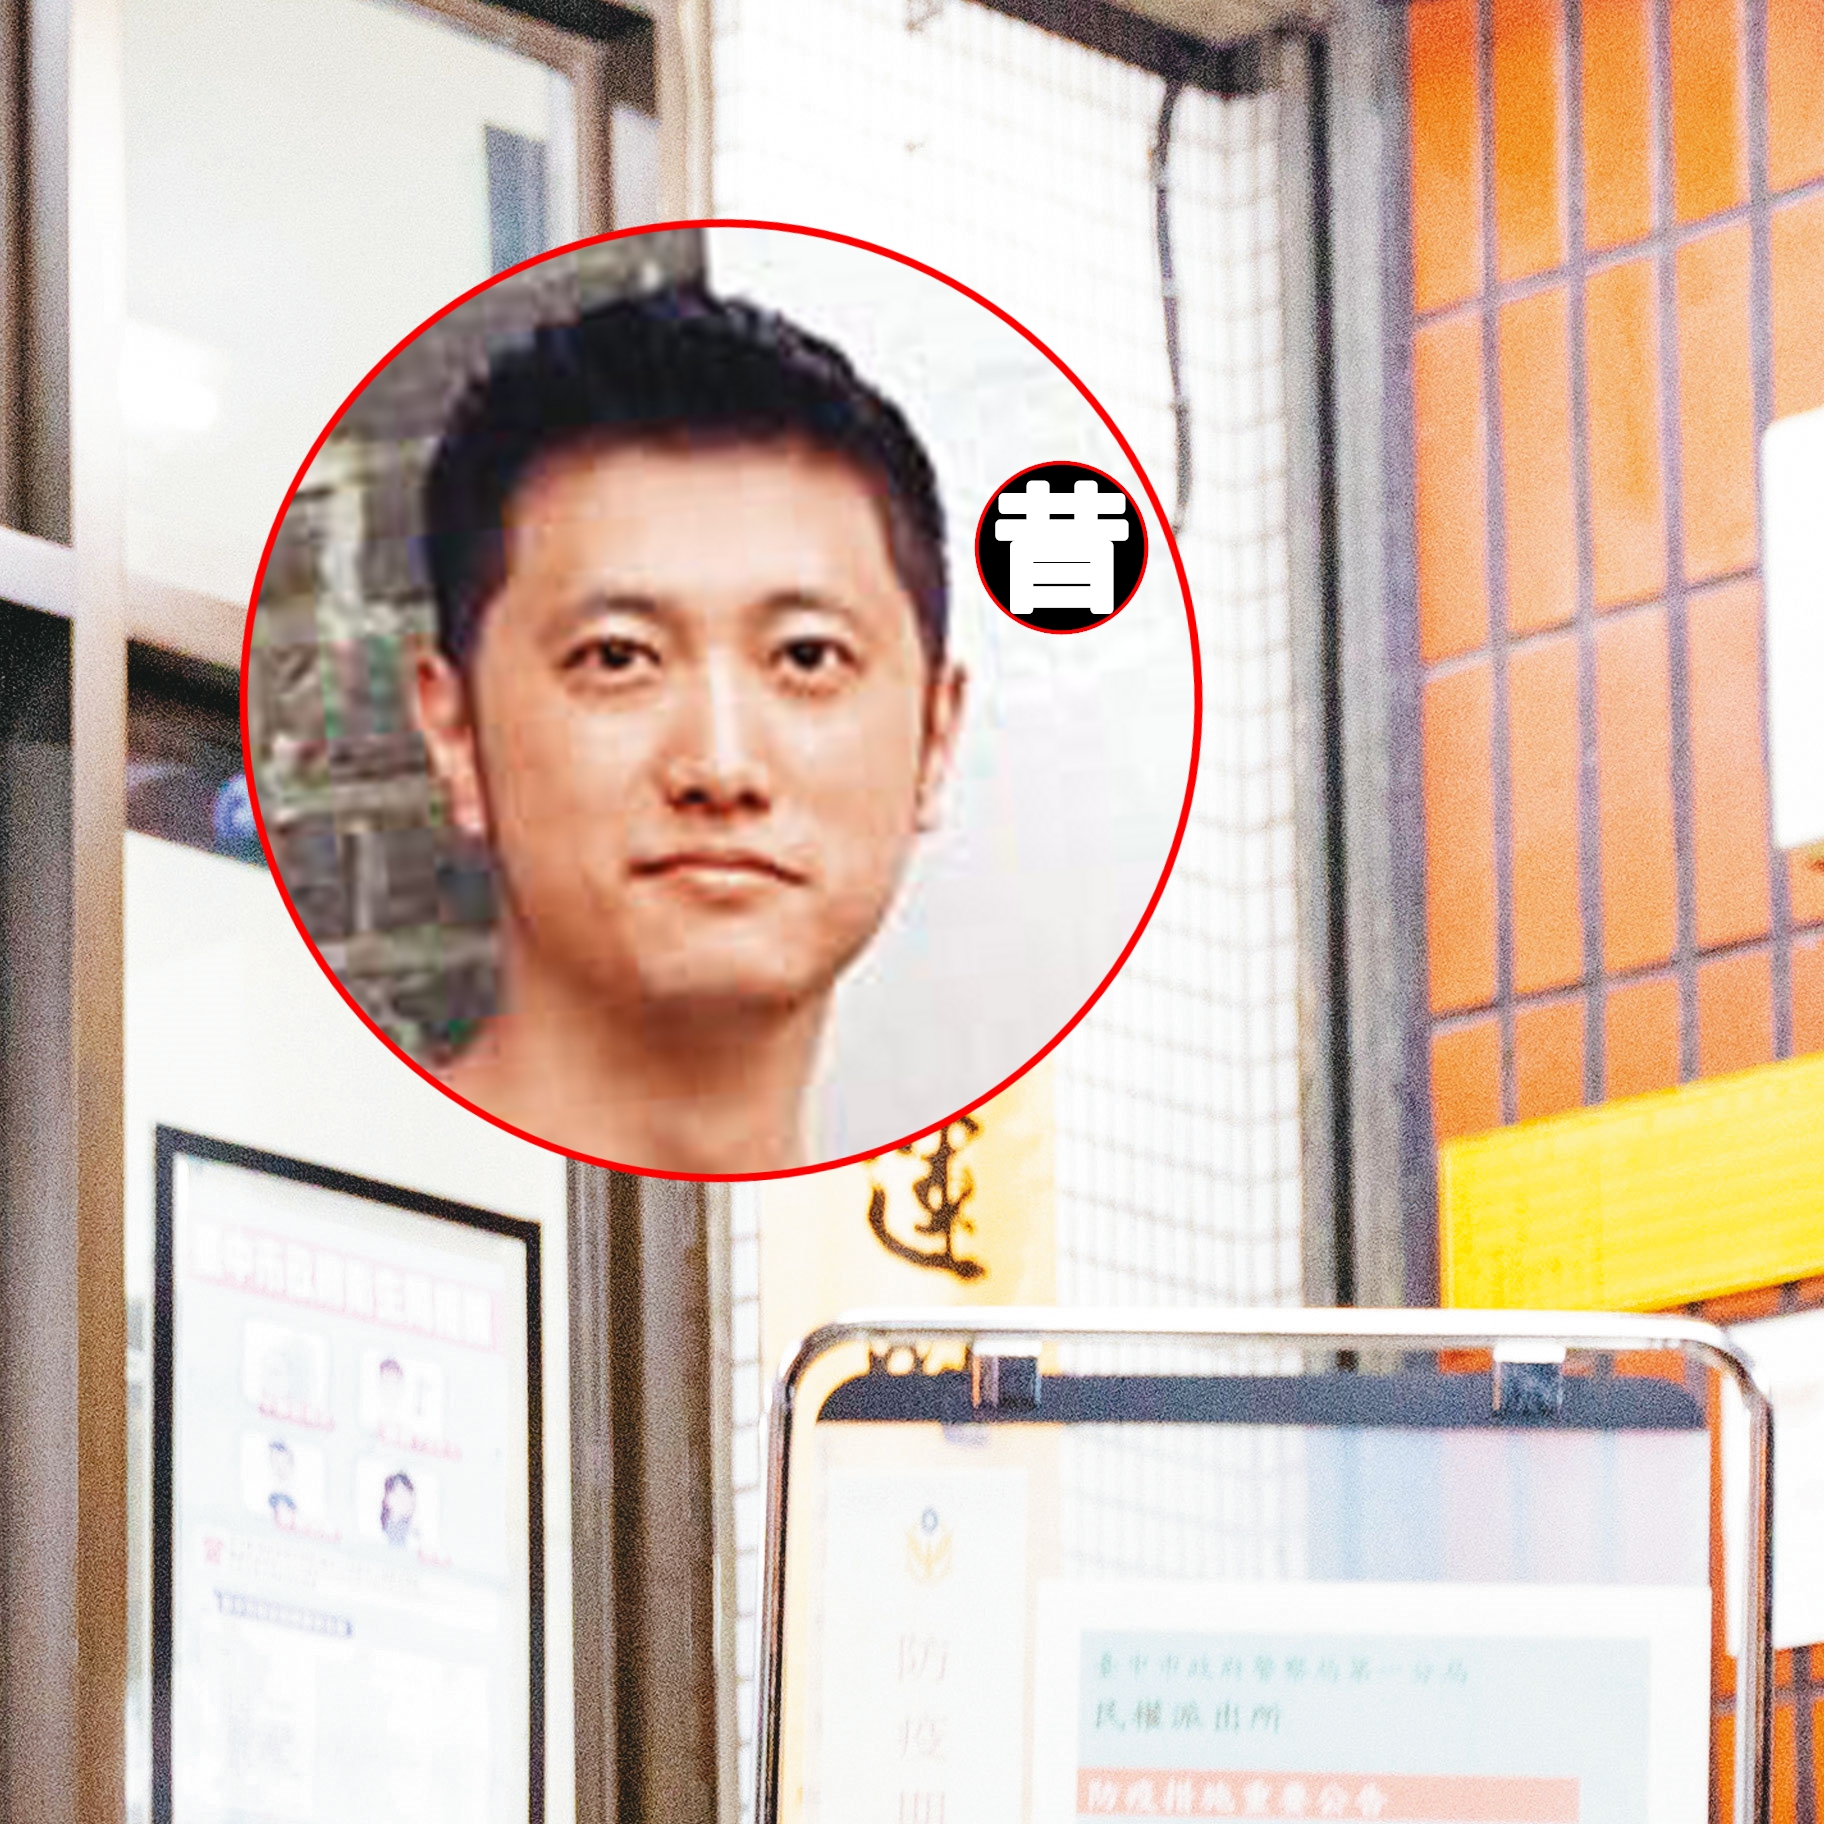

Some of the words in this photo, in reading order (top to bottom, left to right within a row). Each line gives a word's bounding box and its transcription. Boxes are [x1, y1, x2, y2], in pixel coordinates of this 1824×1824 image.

[1096, 1698, 1281, 1733] 民權派出所
[1087, 1776, 1388, 1817] 防疫措施重要公告
